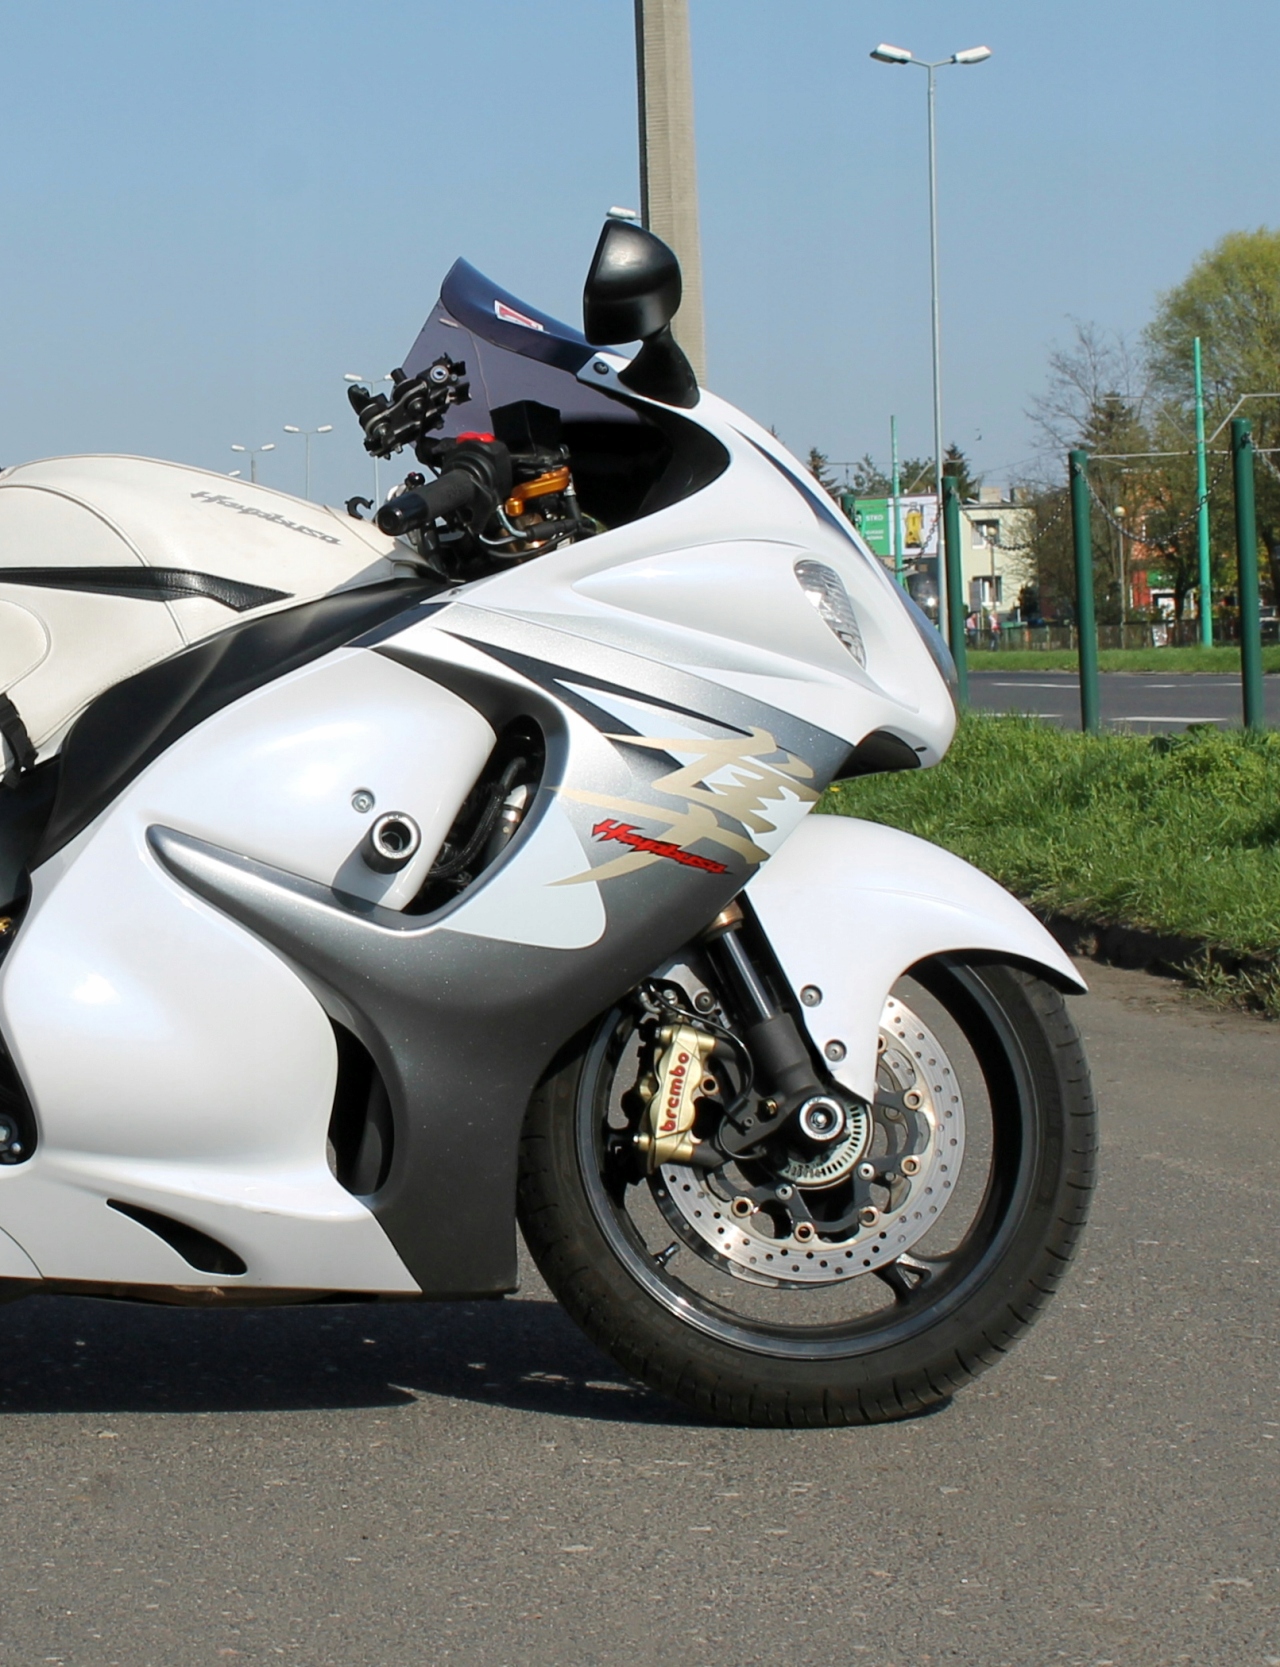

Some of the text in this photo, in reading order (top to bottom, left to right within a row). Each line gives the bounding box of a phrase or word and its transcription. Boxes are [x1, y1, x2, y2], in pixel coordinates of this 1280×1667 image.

[190, 491, 342, 545] Hayabusa
[591, 818, 733, 874] Hayabusa
[659, 1052, 690, 1132] brembo
